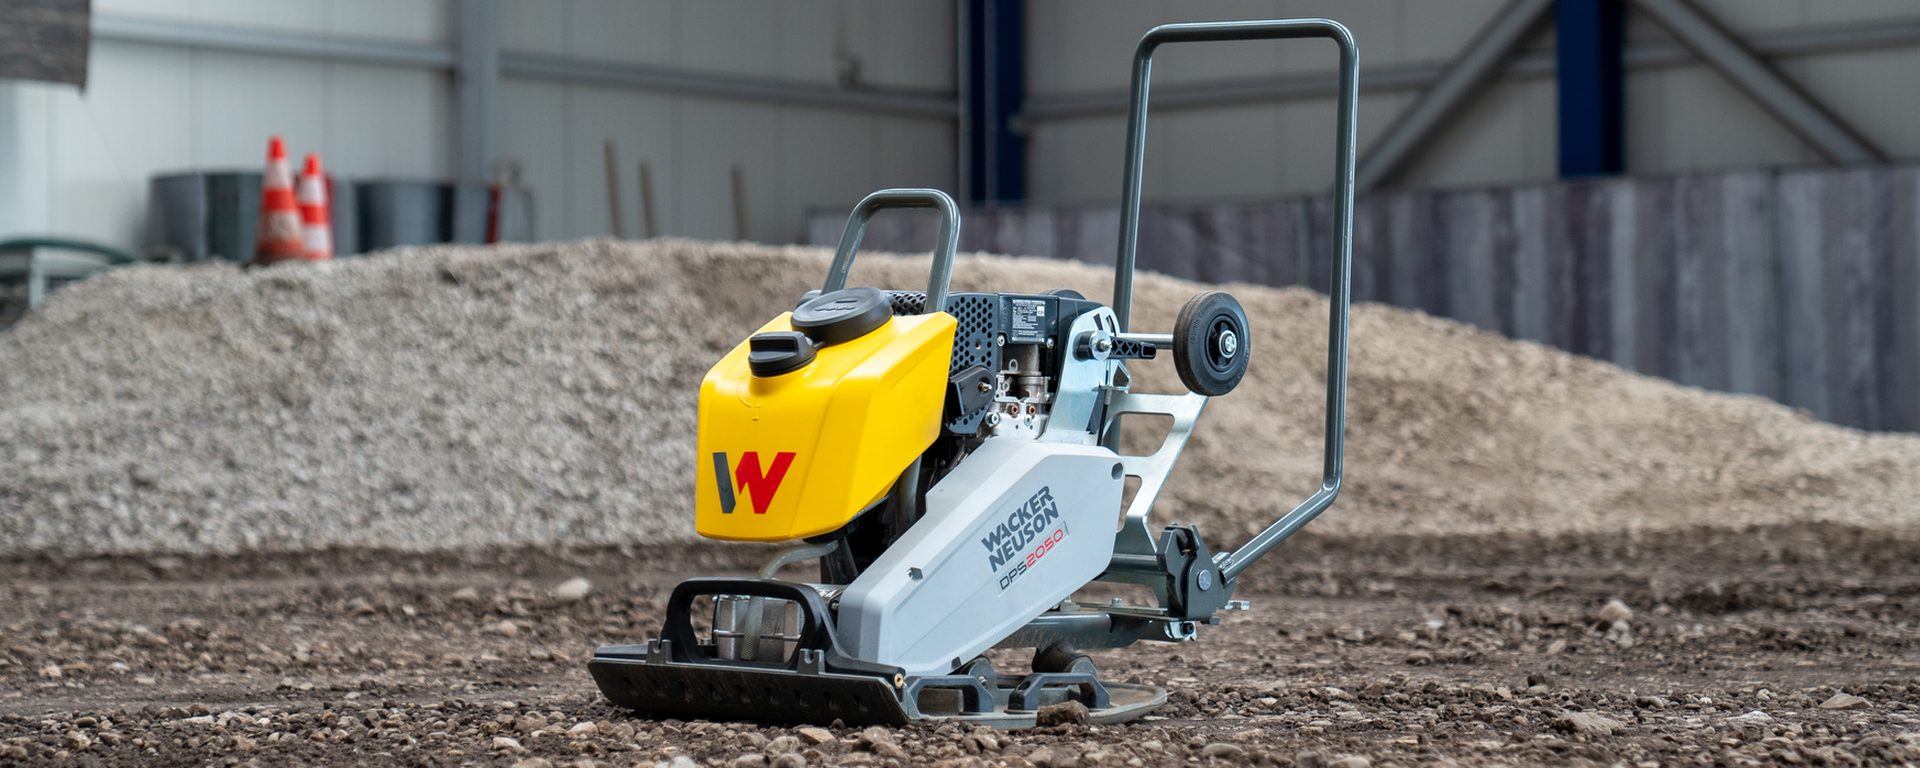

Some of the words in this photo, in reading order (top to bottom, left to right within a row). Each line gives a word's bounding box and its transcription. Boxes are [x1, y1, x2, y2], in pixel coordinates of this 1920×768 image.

[981, 485, 1054, 552] WACKER
[988, 501, 1059, 573] NEUSON
[999, 529, 1064, 590] DPS2050
